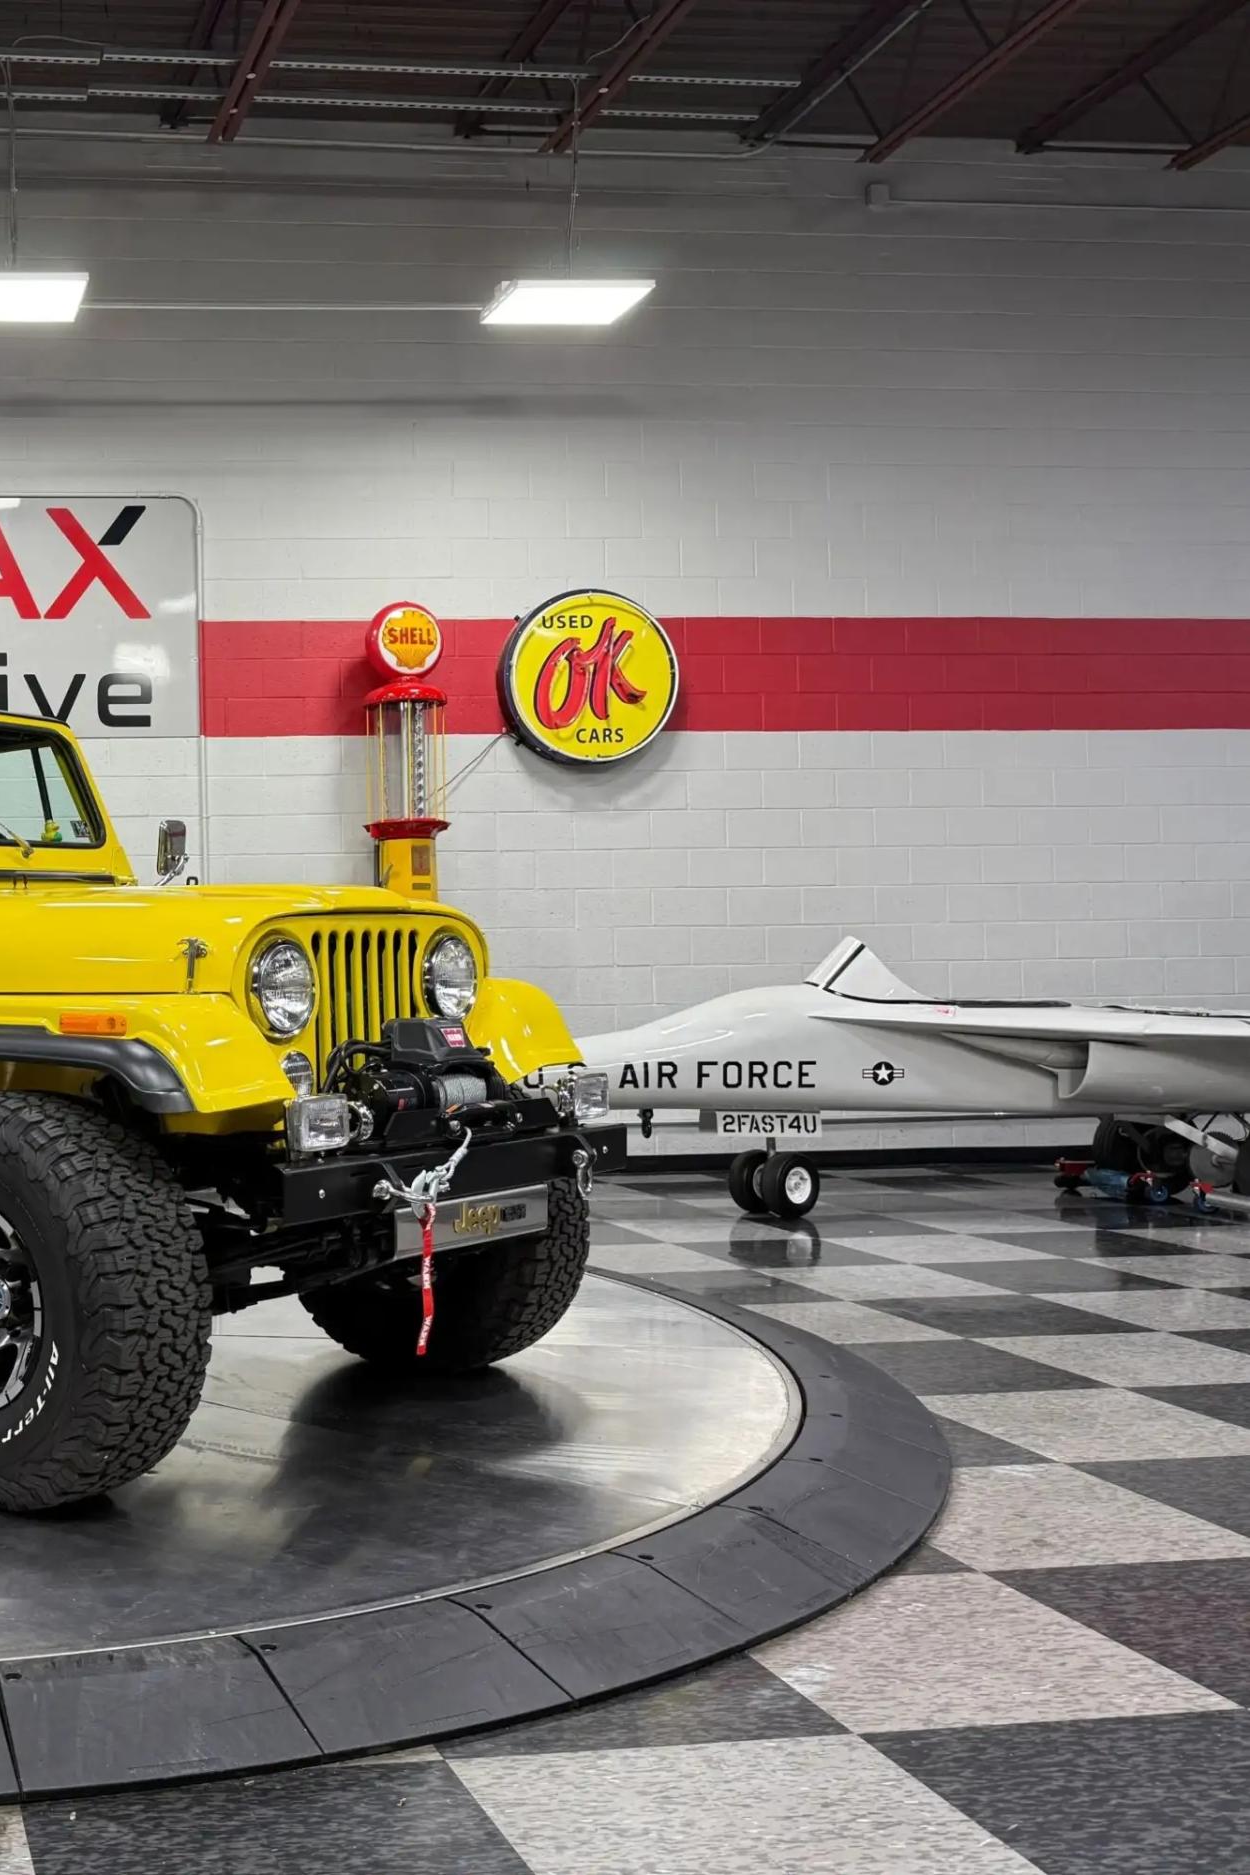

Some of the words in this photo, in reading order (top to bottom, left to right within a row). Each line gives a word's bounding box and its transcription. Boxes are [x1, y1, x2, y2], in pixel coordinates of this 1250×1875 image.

[542, 614, 593, 630] USED
[387, 625, 434, 646] SHELL
[533, 617, 648, 730] OK
[576, 727, 624, 744] CARS
[618, 1060, 679, 1089] AIR
[696, 1060, 817, 1089] FORCE
[721, 1113, 817, 1135] 2FAST4U
[453, 1202, 499, 1235] Jeep
